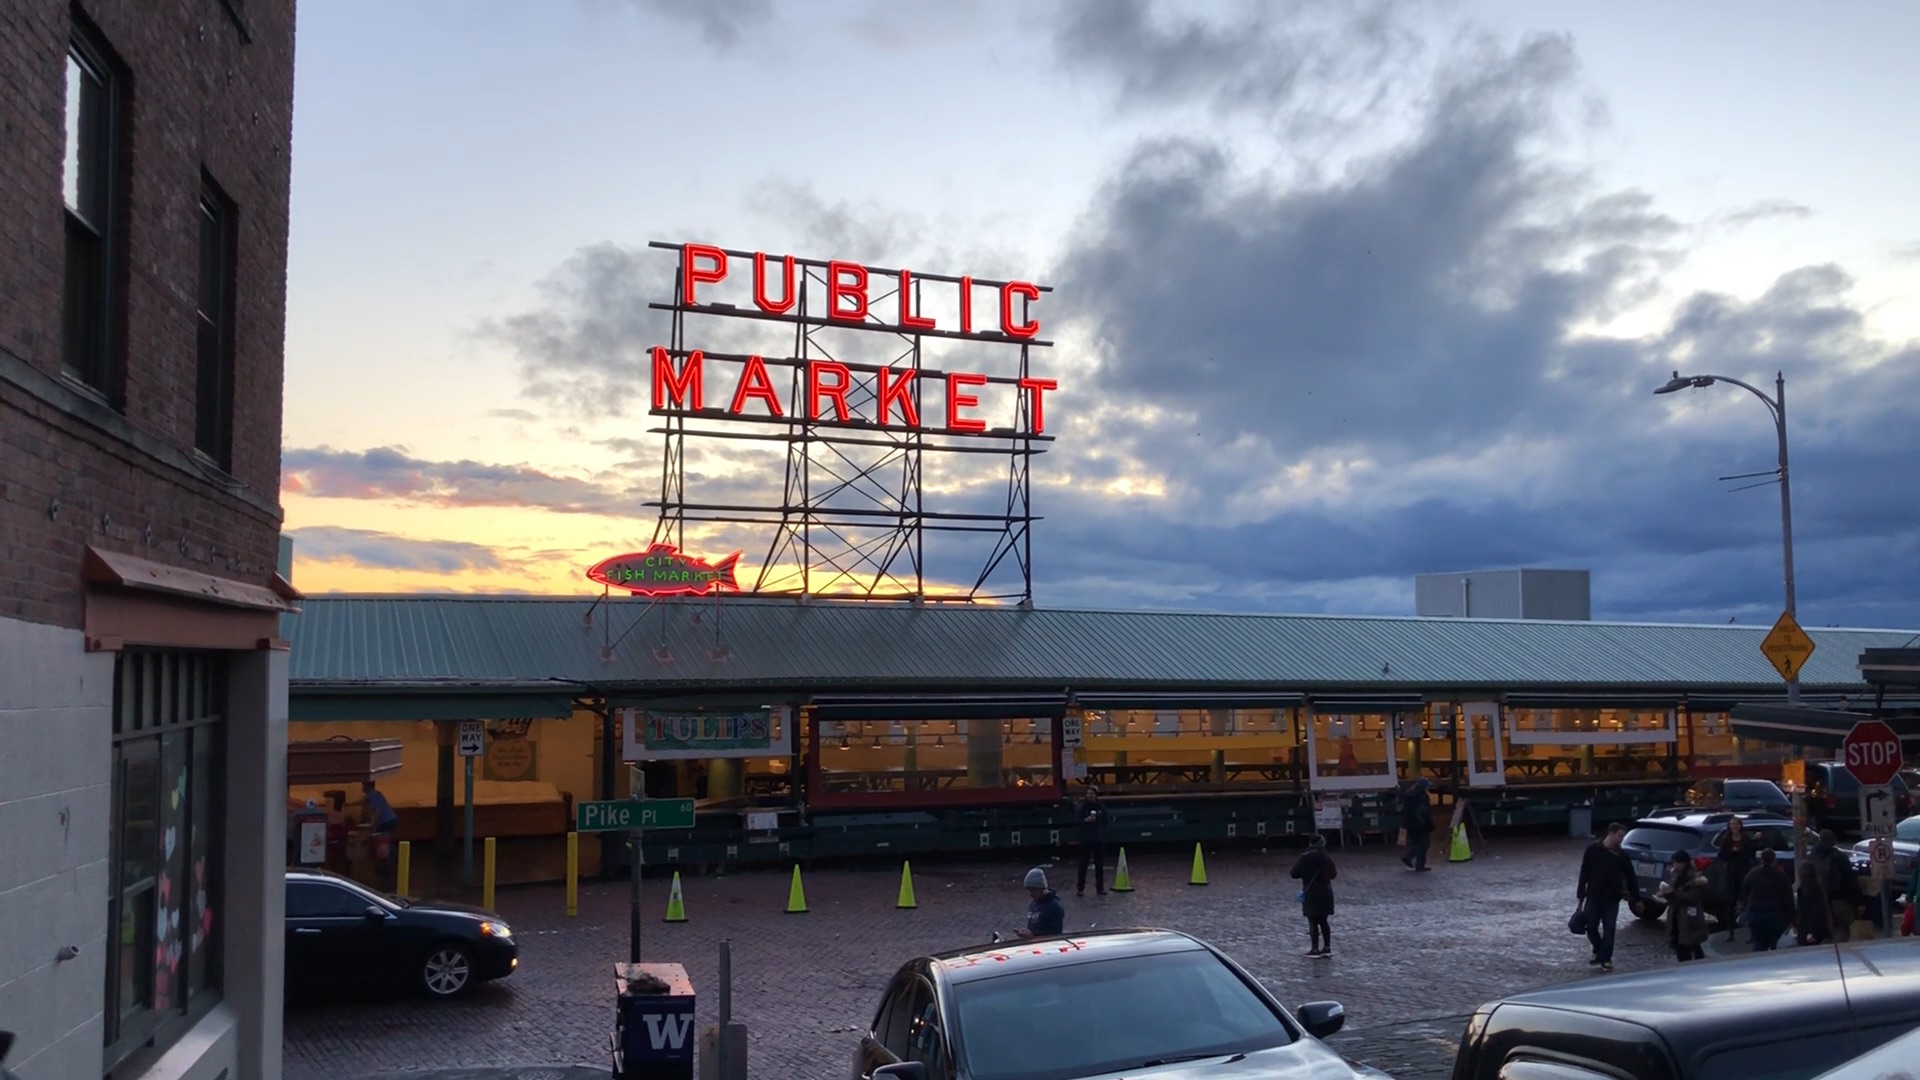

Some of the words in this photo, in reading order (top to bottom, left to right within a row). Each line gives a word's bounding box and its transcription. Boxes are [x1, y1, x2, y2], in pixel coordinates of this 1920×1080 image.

[682, 242, 1041, 338] PUBLIC
[651, 345, 1058, 436] MARKET
[645, 556, 687, 567] CITY
[606, 570, 645, 580] FISH
[653, 570, 722, 581] MARKET
[461, 723, 482, 732] ONE
[461, 733, 482, 742] WAY
[648, 715, 768, 741] TULIPS
[1849, 741, 1898, 766] STOP
[585, 804, 630, 826] Pike
[680, 803, 693, 812] 60
[642, 1013, 694, 1050] W
